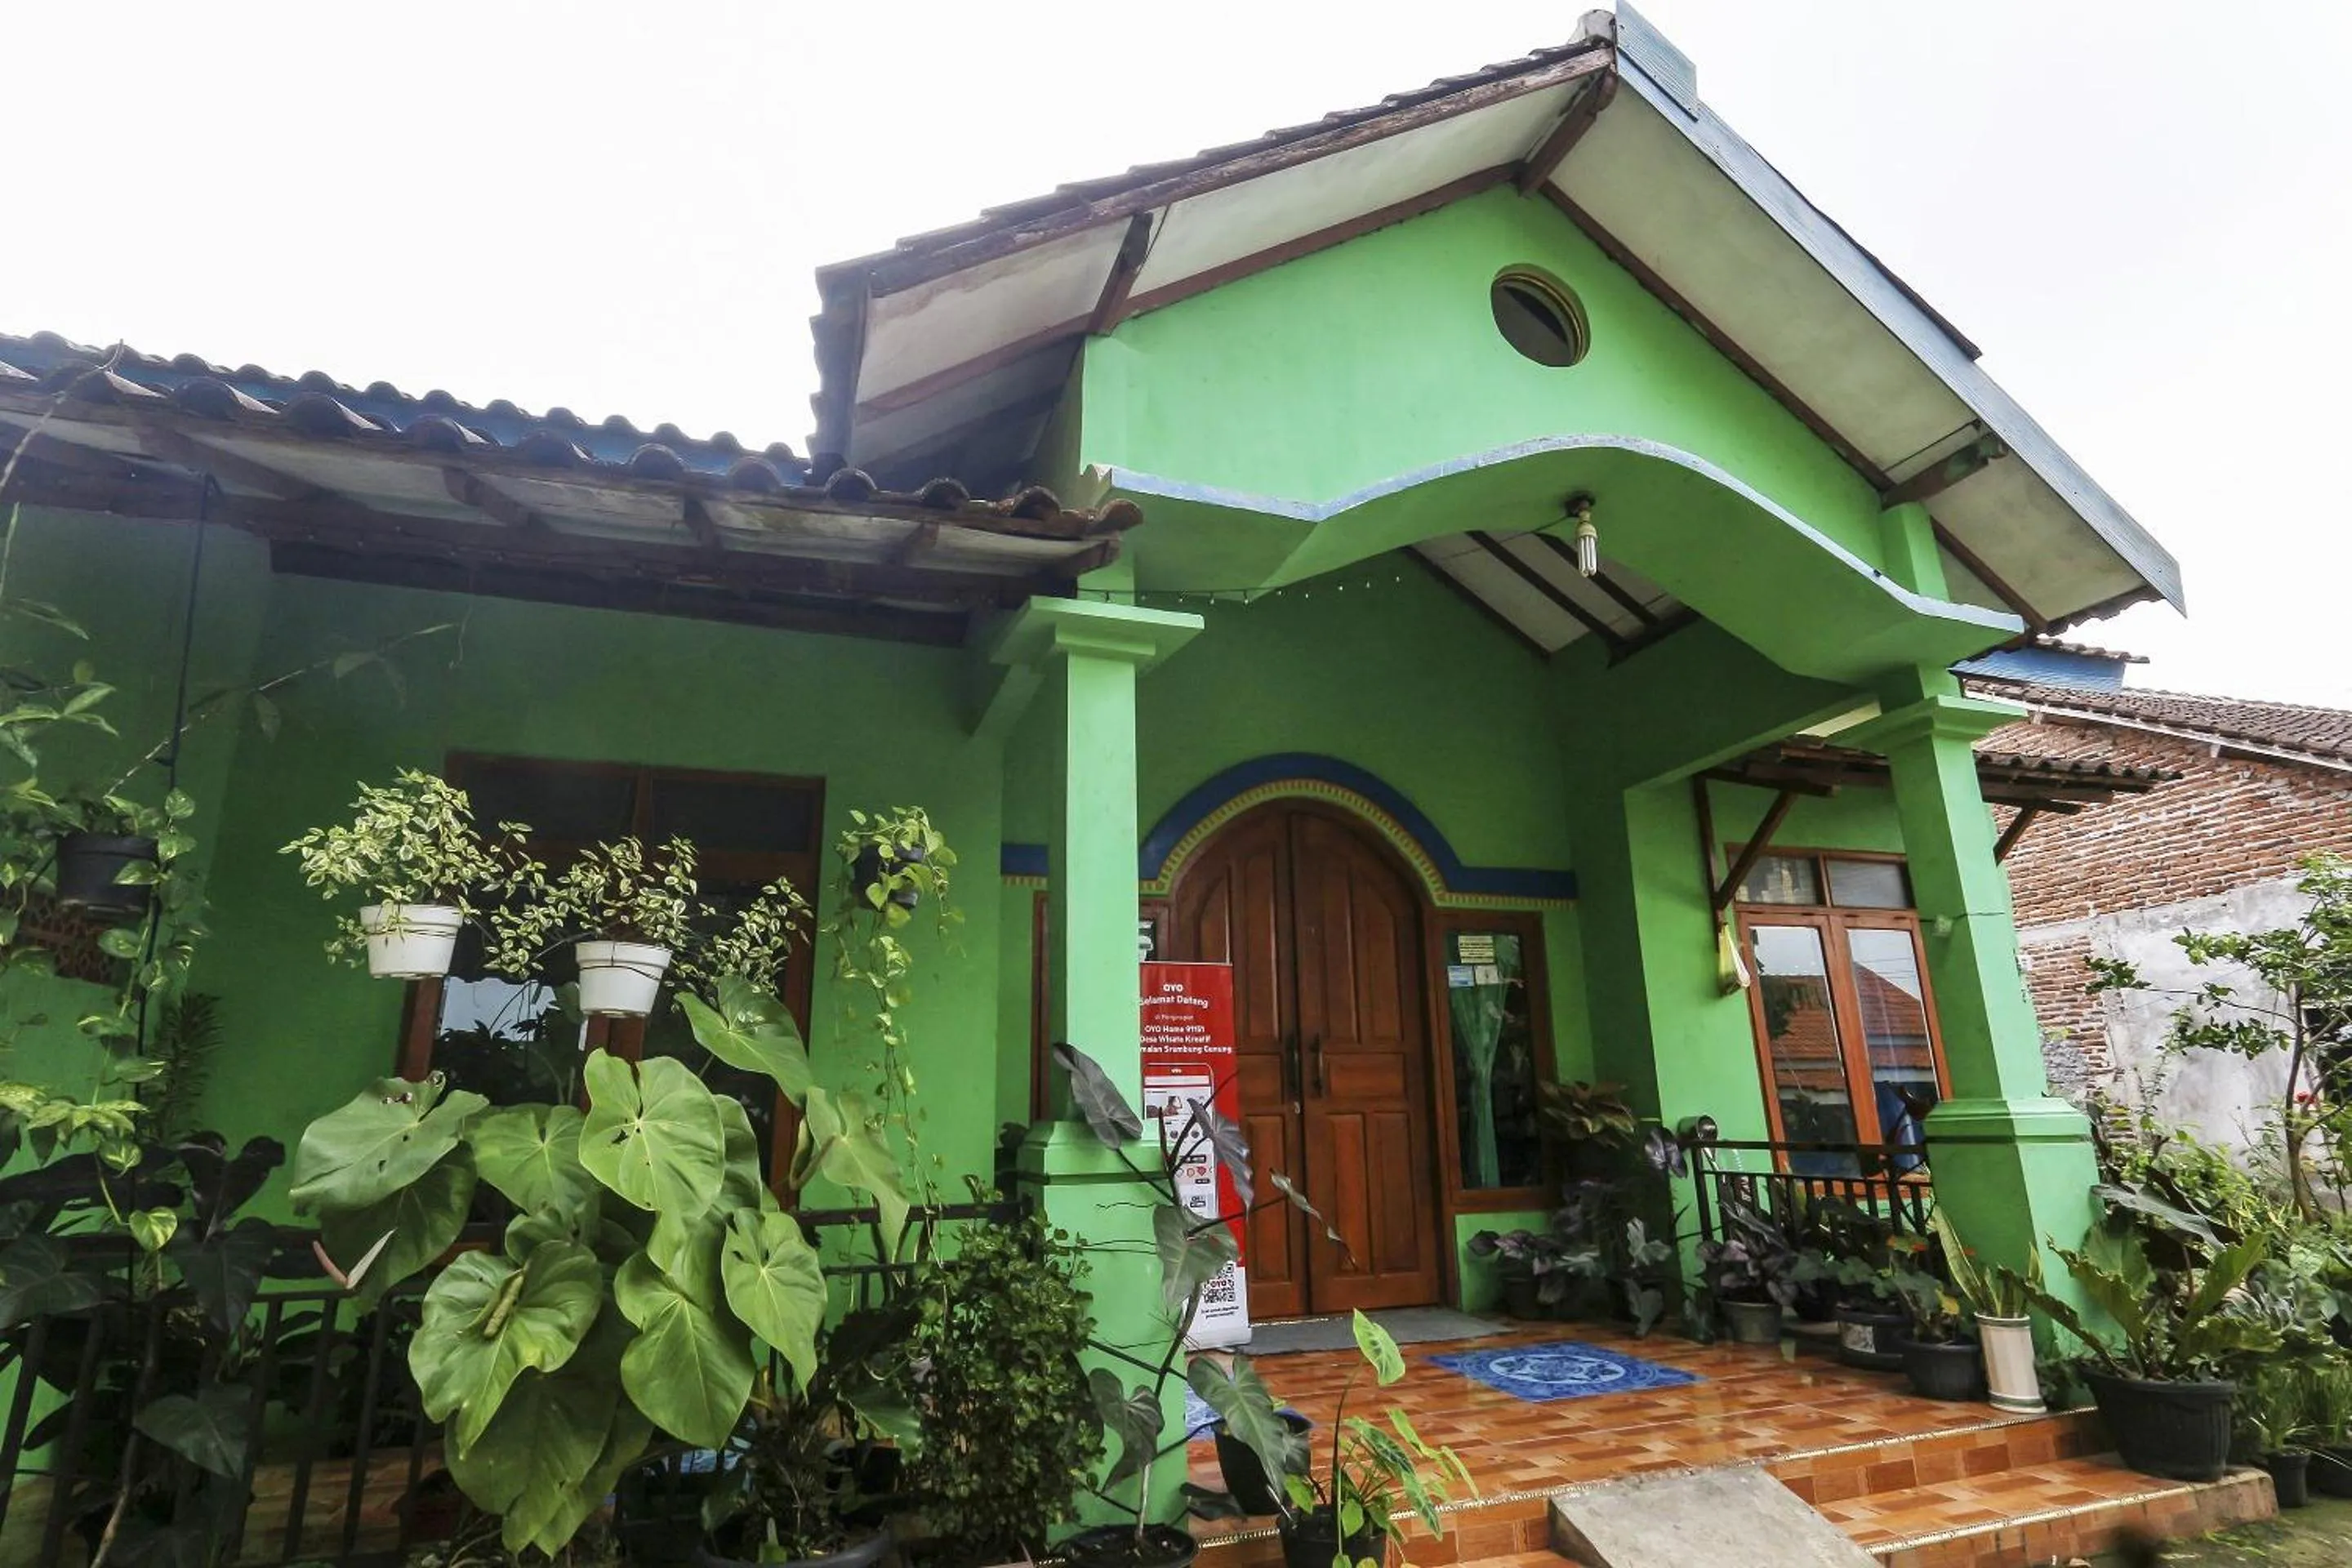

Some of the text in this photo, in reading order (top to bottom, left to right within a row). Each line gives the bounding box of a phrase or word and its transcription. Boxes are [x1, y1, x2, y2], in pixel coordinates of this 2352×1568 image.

[1163, 983, 1183, 992] OYO
[1177, 995, 1209, 1009] Datang
[1144, 1025, 1161, 1033] OYO
[1158, 1035, 1184, 1043] Wisata
[1185, 1035, 1211, 1044] Kreatif
